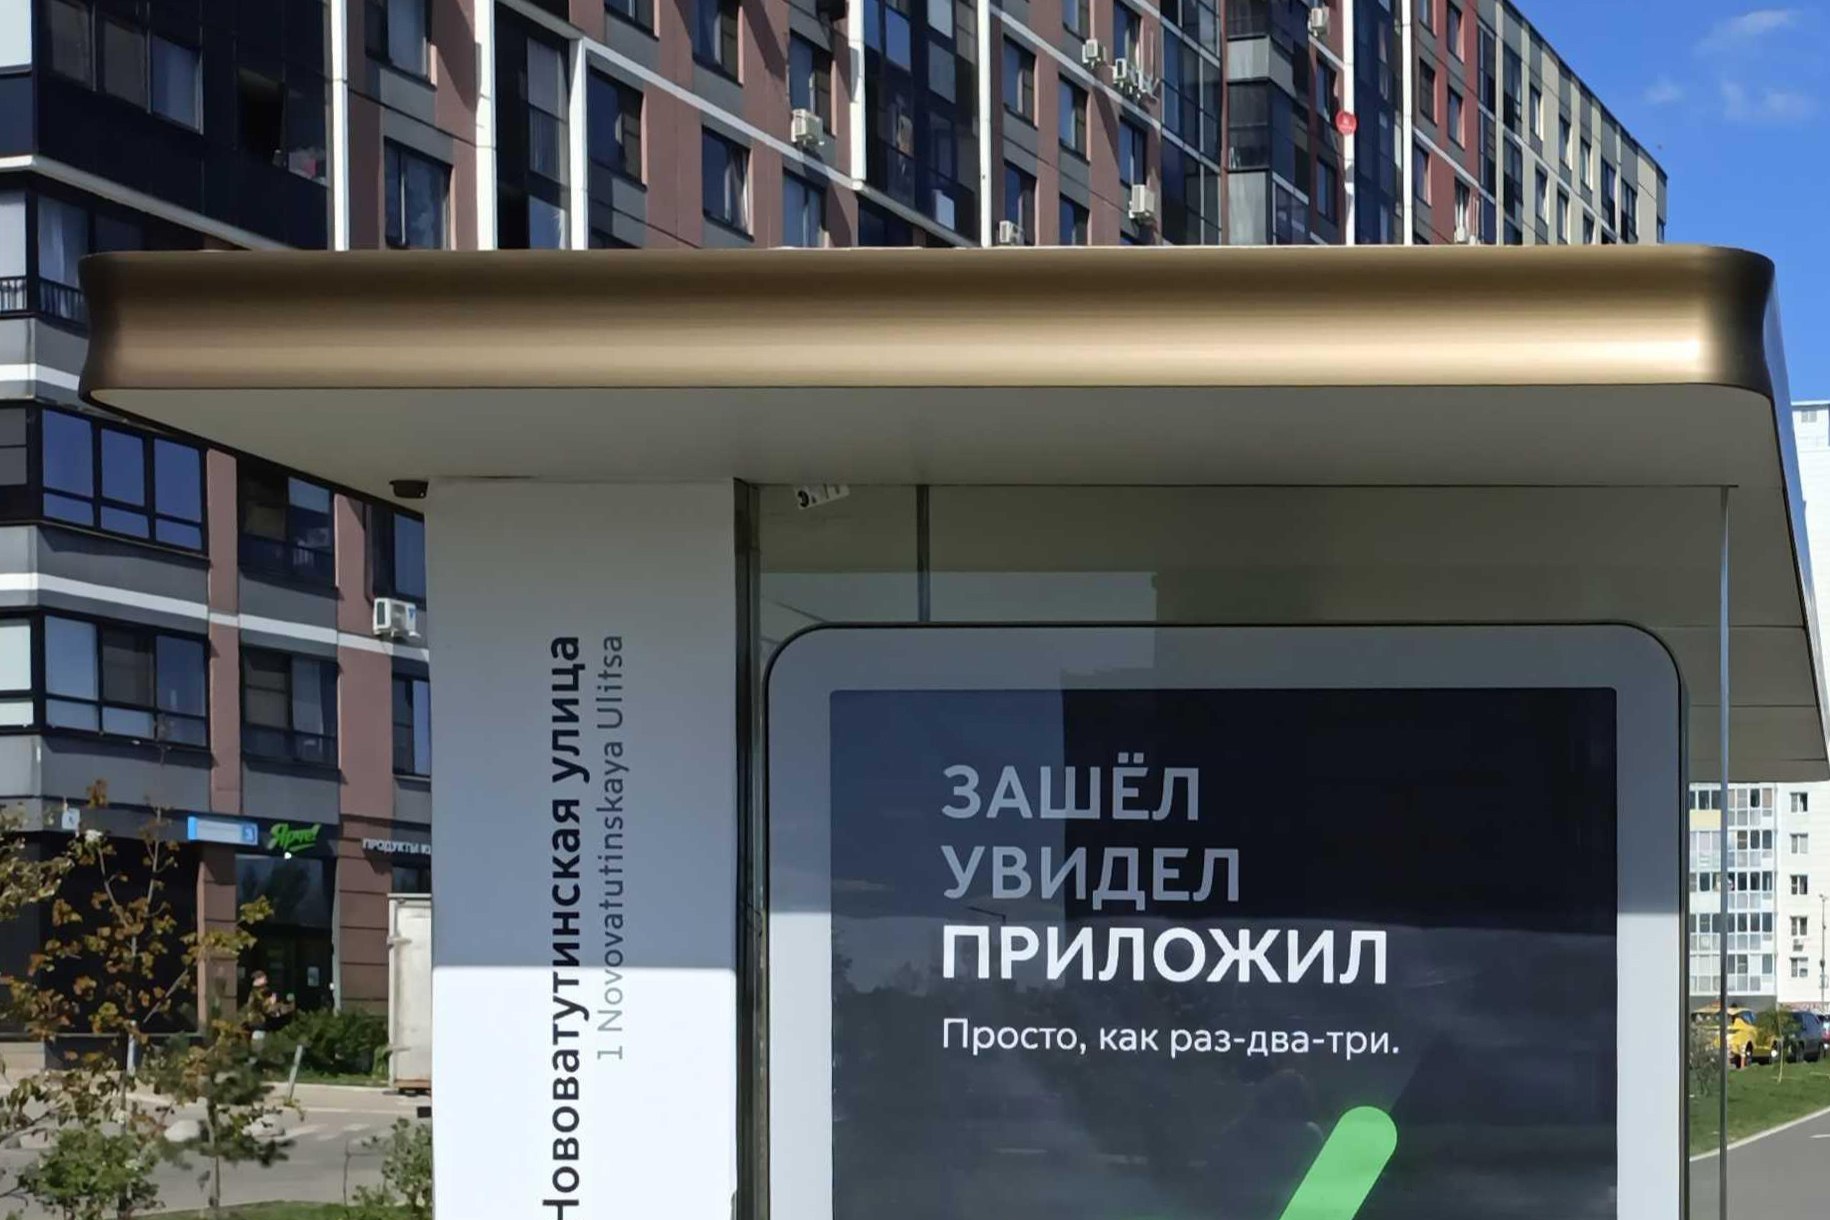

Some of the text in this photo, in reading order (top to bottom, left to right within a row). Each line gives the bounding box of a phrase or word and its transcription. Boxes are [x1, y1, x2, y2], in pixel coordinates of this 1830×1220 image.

[551, 636, 590, 783] улица
[941, 752, 1199, 821] ЗАШЁЛ
[596, 635, 630, 1060] 1 Novovatutinskaya Ulitsa
[941, 845, 1240, 911] УВИДЕЛ
[942, 924, 1388, 985] ПРИЛОЖИЛ
[942, 1017, 1400, 1061] Просто, как раз-два-три.
